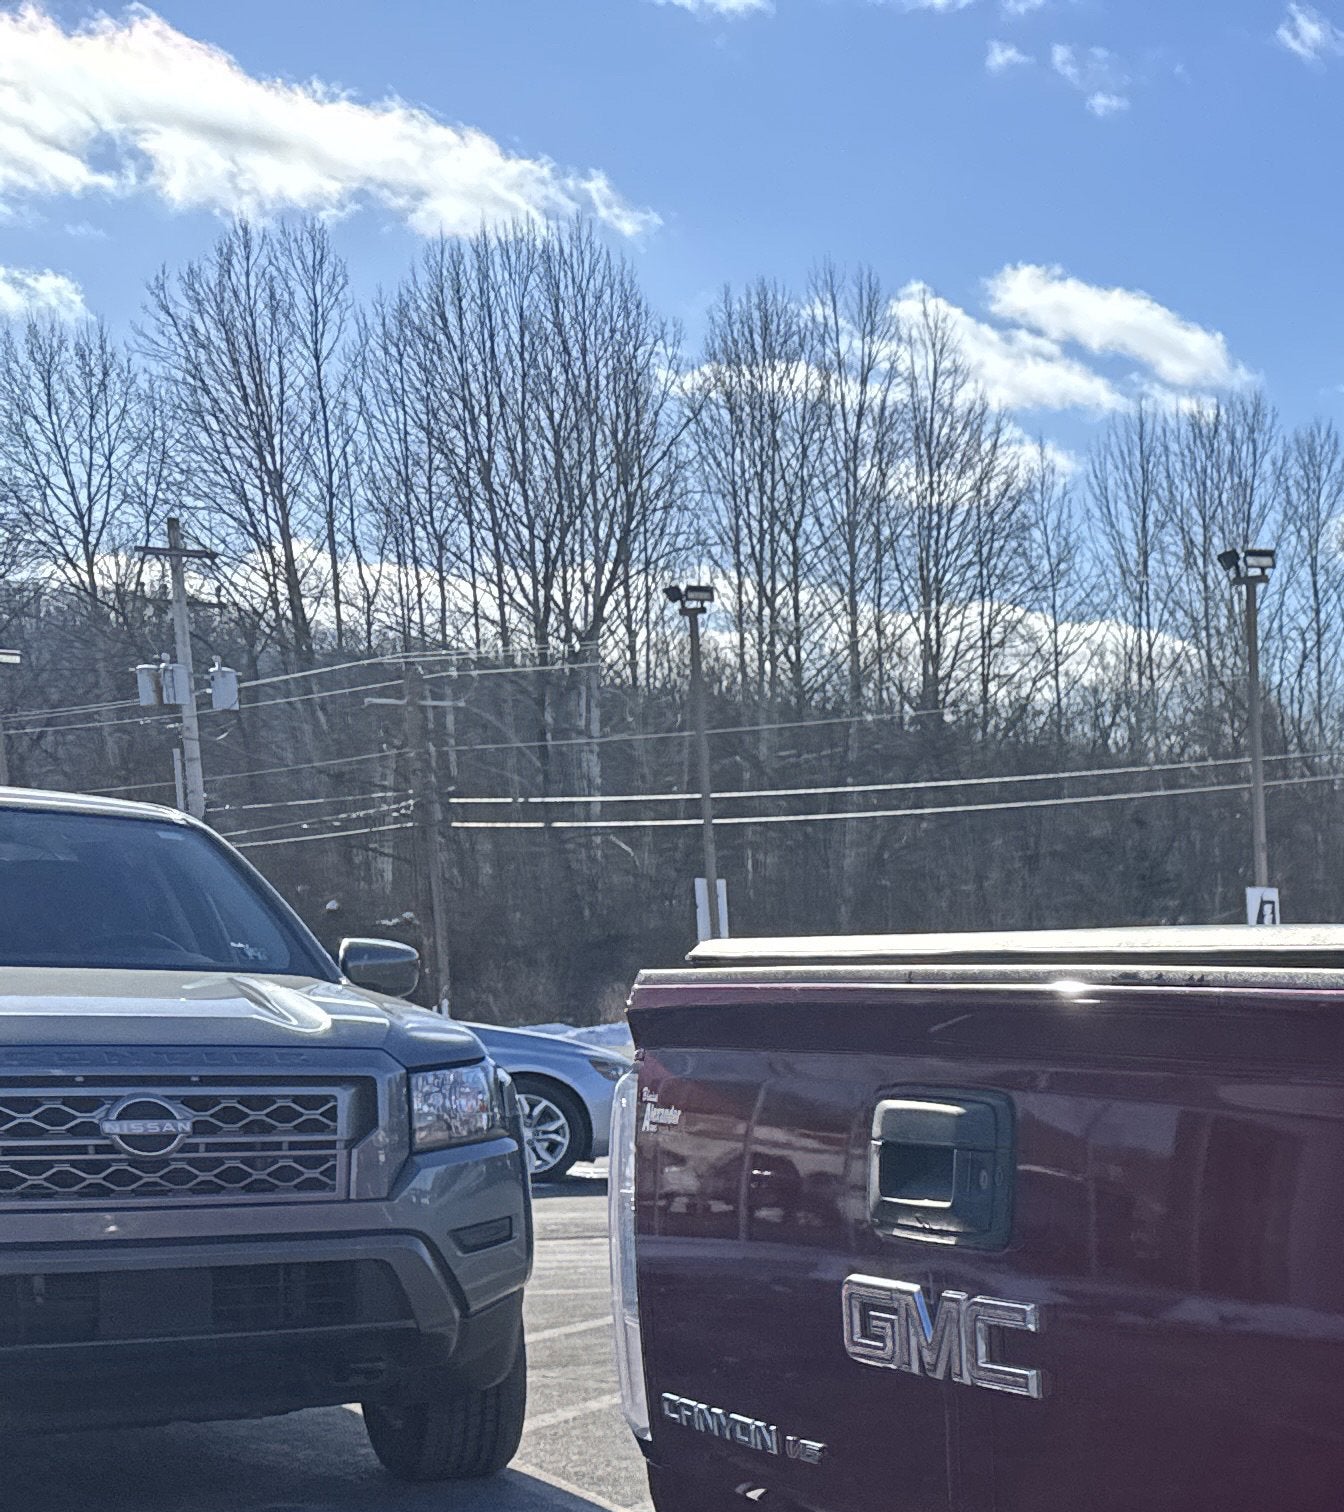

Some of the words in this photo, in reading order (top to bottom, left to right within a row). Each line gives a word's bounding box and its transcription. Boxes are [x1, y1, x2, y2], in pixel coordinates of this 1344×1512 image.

[104, 1121, 192, 1134] NISSAN
[842, 1273, 1043, 1400] GMC
[662, 1392, 780, 1456] CANYON
[785, 1435, 828, 1465] V6
